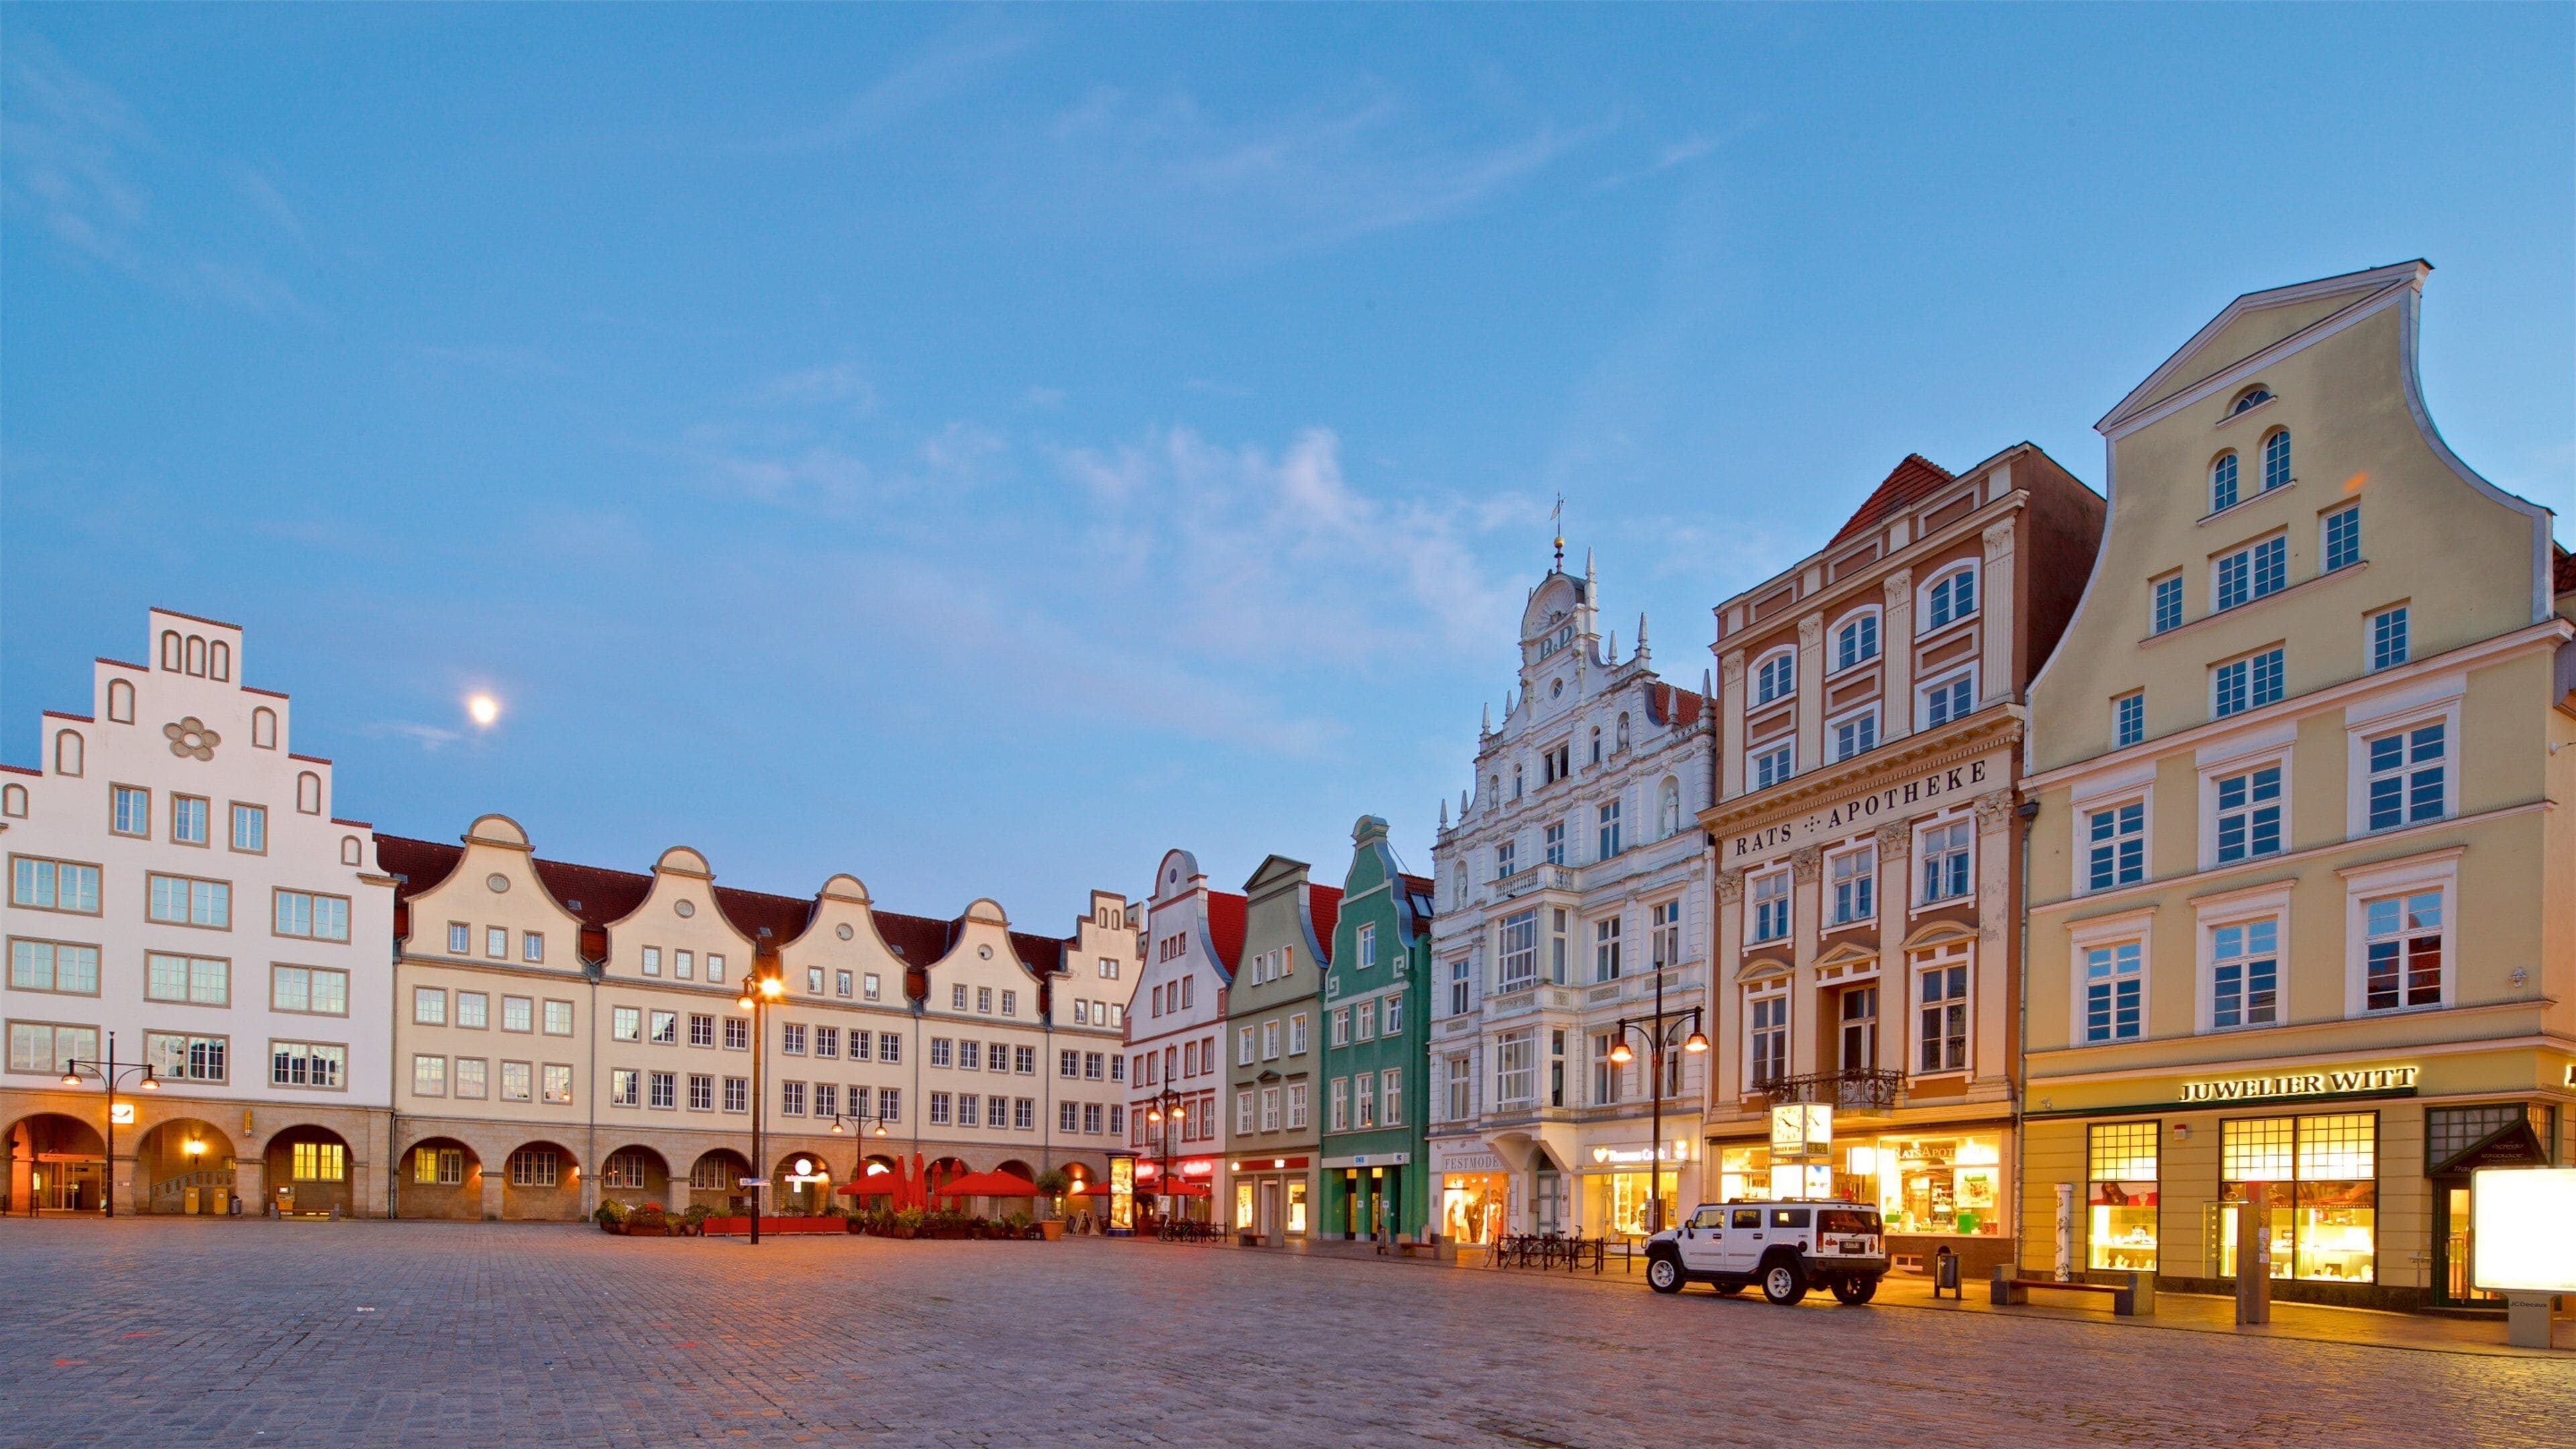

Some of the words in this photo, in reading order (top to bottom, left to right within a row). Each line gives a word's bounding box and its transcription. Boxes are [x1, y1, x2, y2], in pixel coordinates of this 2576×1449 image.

[1735, 824, 1791, 857] RATS
[1828, 759, 1986, 829] APOTHEKE
[2179, 1075, 2322, 1101] JUWELIER
[2329, 1067, 2416, 1091] WITT
[1445, 1155, 1503, 1169] FESTMODE
